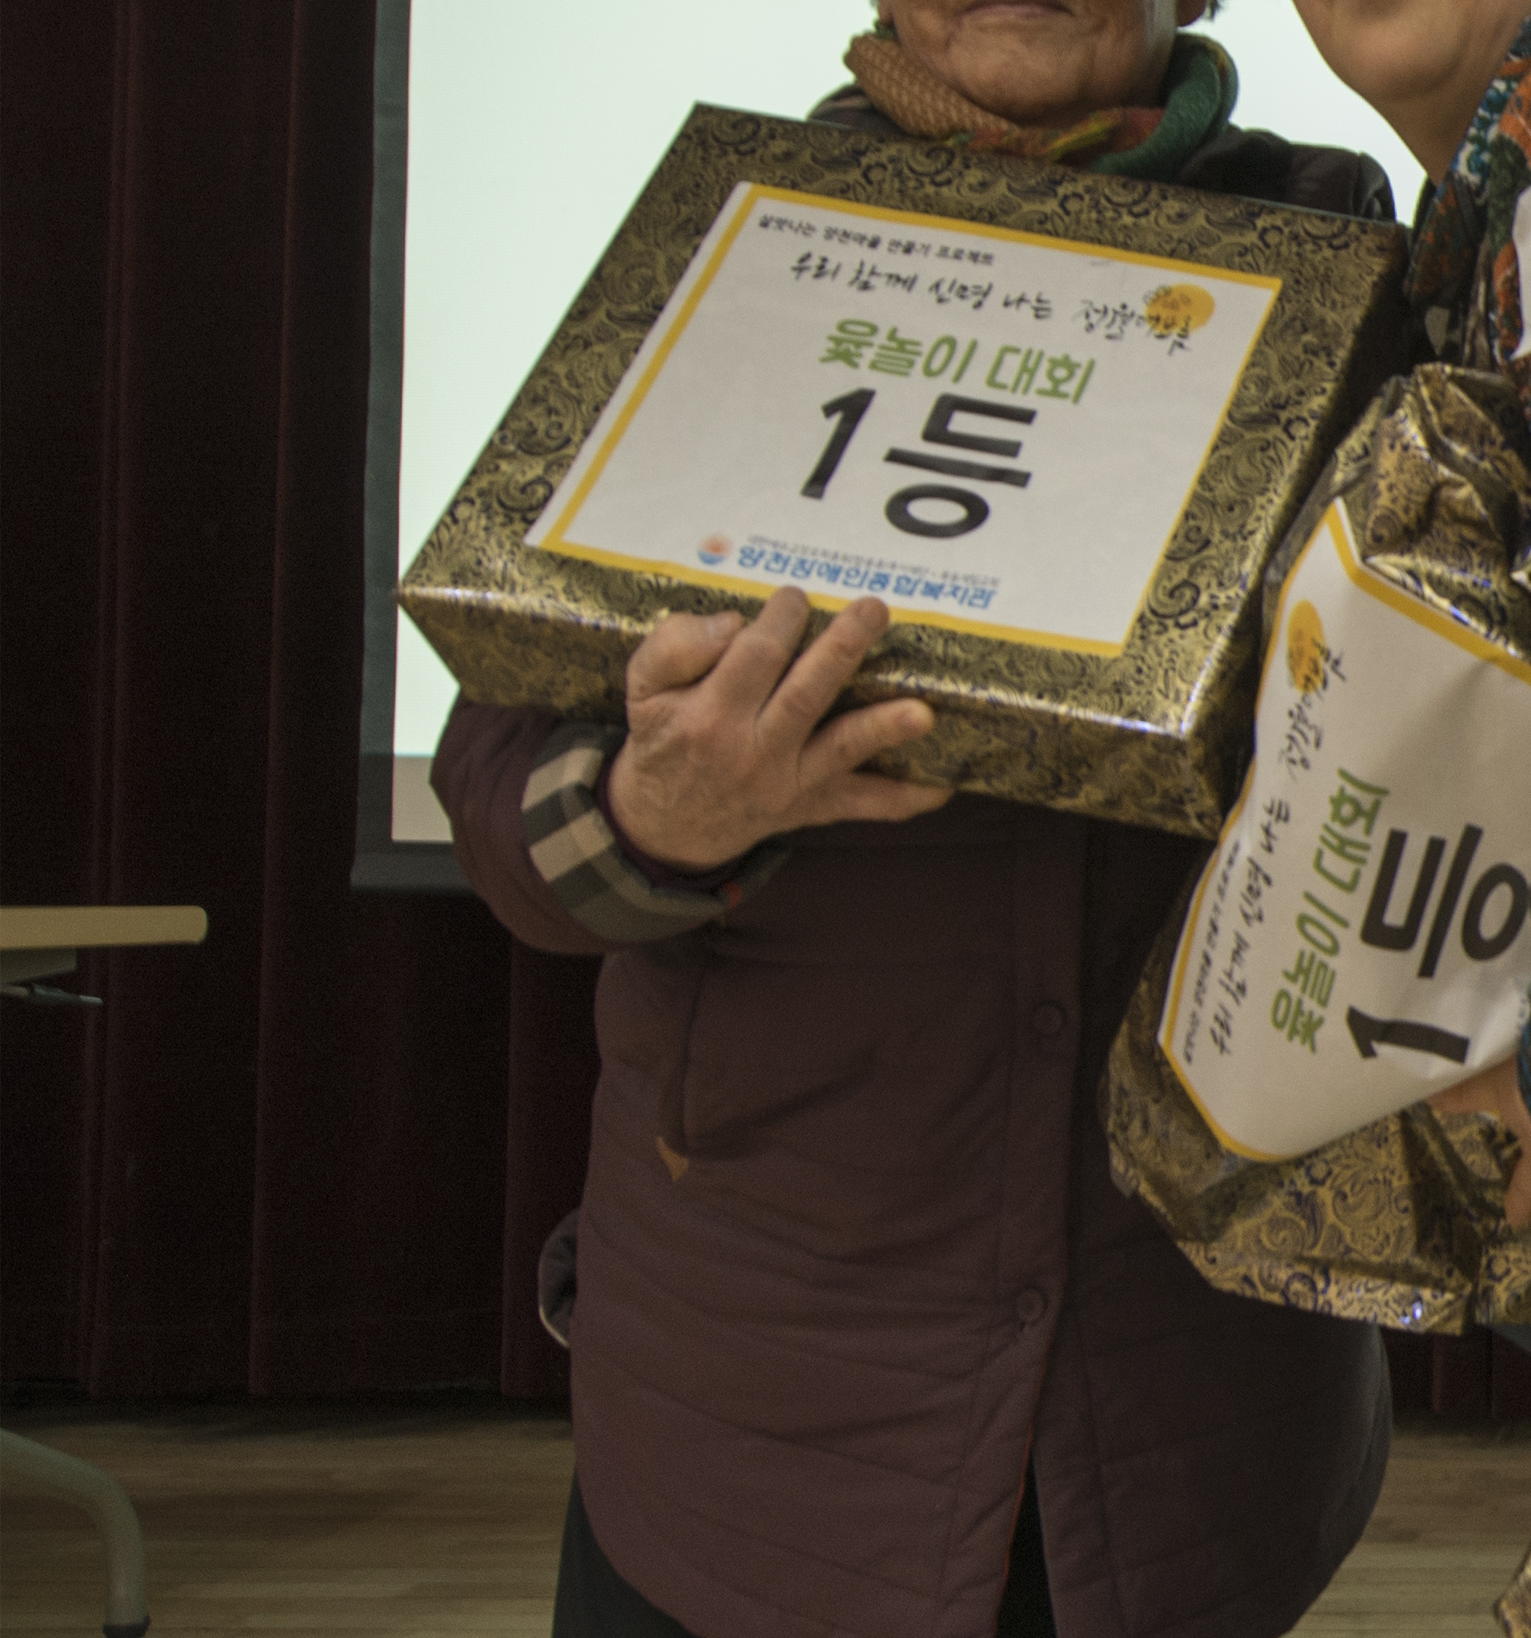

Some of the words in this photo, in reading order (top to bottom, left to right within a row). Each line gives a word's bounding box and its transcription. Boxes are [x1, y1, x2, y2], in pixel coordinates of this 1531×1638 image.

[818, 318, 979, 384] 윷놀이
[985, 344, 1096, 405] 대회
[800, 387, 1038, 539] 1등
[1270, 890, 1351, 1055] 윷놀이
[1312, 766, 1390, 895] 대회
[1346, 824, 1531, 1066] 1등
